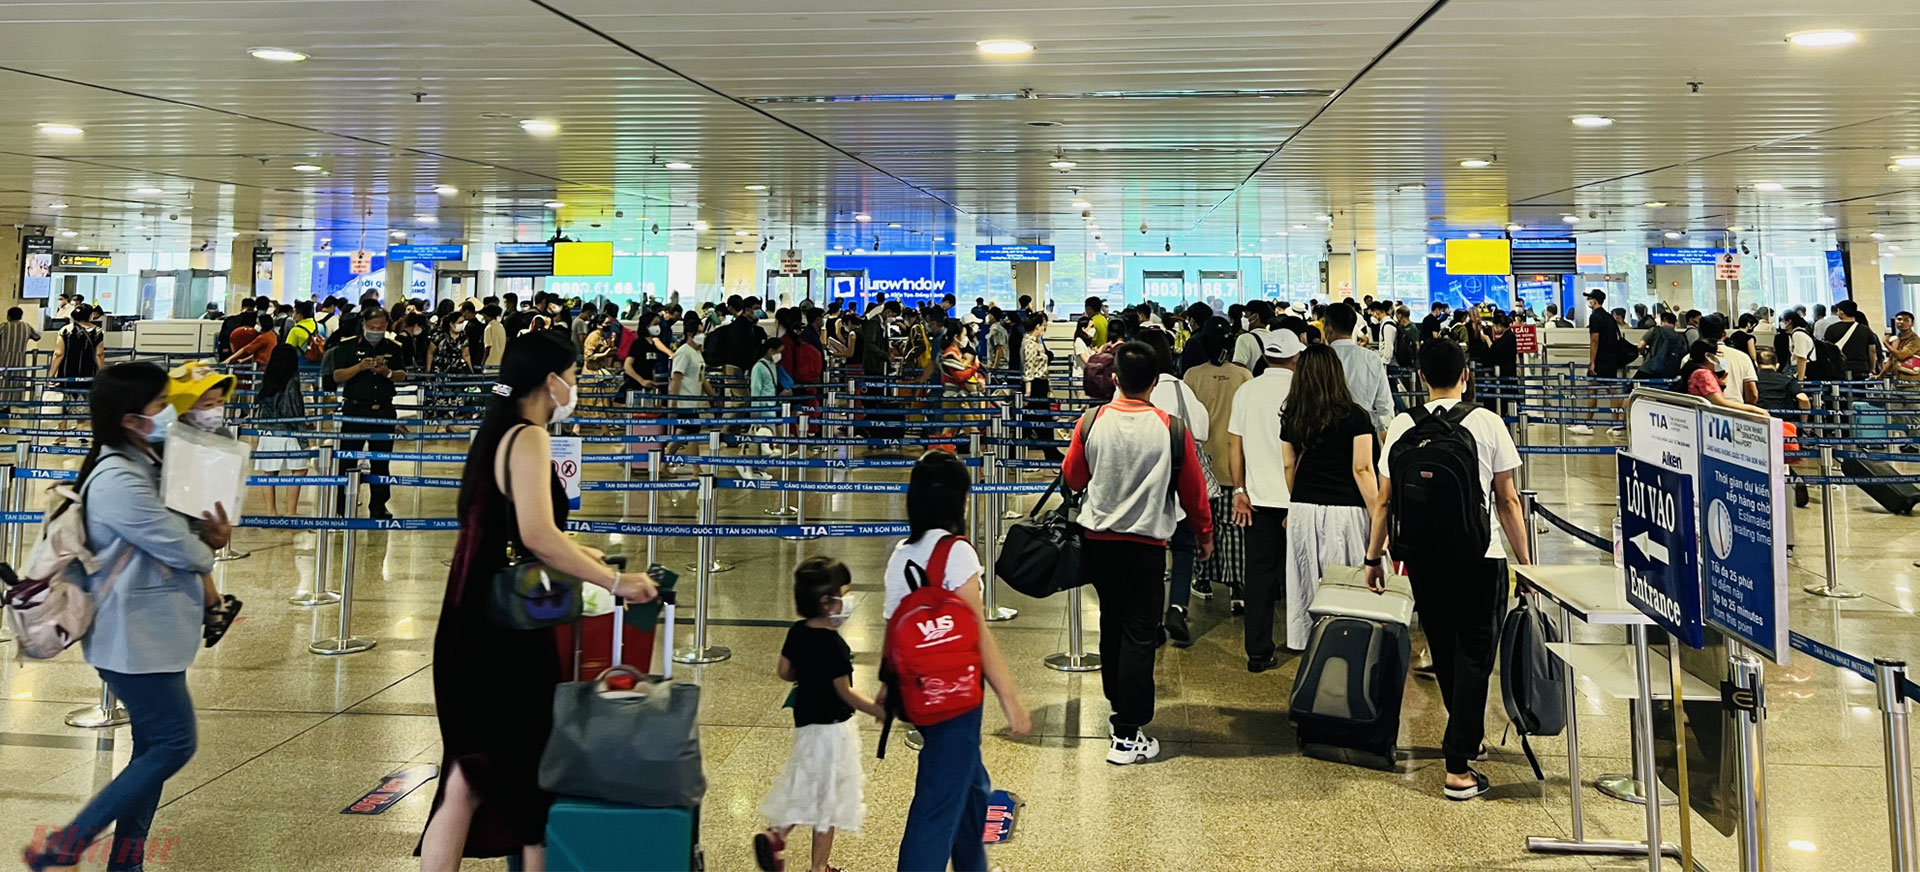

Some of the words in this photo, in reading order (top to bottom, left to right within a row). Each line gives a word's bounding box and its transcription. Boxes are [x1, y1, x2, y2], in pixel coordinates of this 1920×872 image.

[1649, 412, 1668, 429] TIA
[1662, 451, 1682, 469] Aiken
[378, 476, 398, 484] TIA
[733, 480, 756, 488] TIA
[886, 483, 902, 492] NHẤT
[1729, 476, 1743, 489] gian
[1625, 460, 1646, 519] LỐI
[1647, 474, 1676, 533] VÀO
[376, 520, 401, 528] TIA
[1738, 508, 1771, 530] Estimated
[715, 526, 723, 534] TẾ
[800, 526, 827, 535] TIA
[1734, 525, 1755, 542] waiting
[1756, 532, 1772, 546] time
[1730, 569, 1737, 582] 25
[1738, 574, 1754, 591] phút
[1629, 565, 1681, 627] Entrance
[1712, 591, 1721, 604] Up
[1728, 599, 1736, 612] 25
[1737, 604, 1763, 626] minutes
[1738, 619, 1753, 636] point
[1813, 645, 1824, 656] TAN
[1824, 650, 1836, 660] SON
[1836, 655, 1850, 667] NHAT
